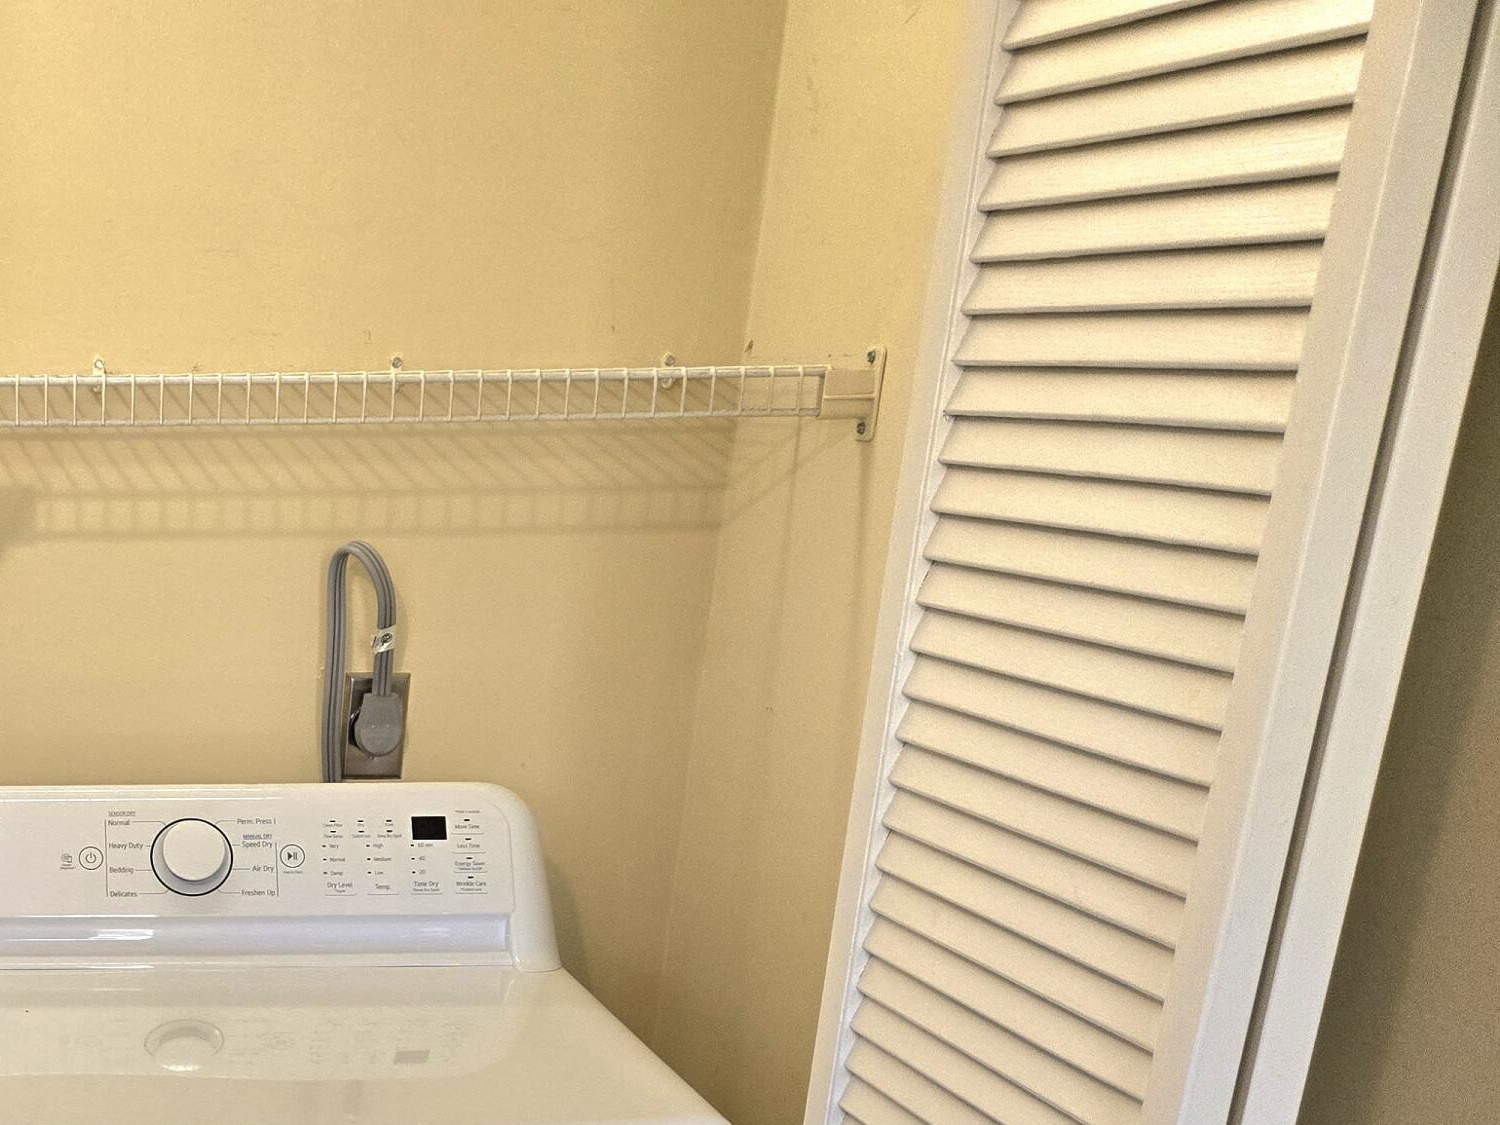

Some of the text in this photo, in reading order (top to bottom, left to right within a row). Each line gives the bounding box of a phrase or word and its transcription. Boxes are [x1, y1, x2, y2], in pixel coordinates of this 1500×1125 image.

[108, 842, 144, 850] Heavy Duty
[242, 841, 261, 849] Speed
[109, 866, 134, 874] Bedding
[263, 865, 275, 873] Dry
